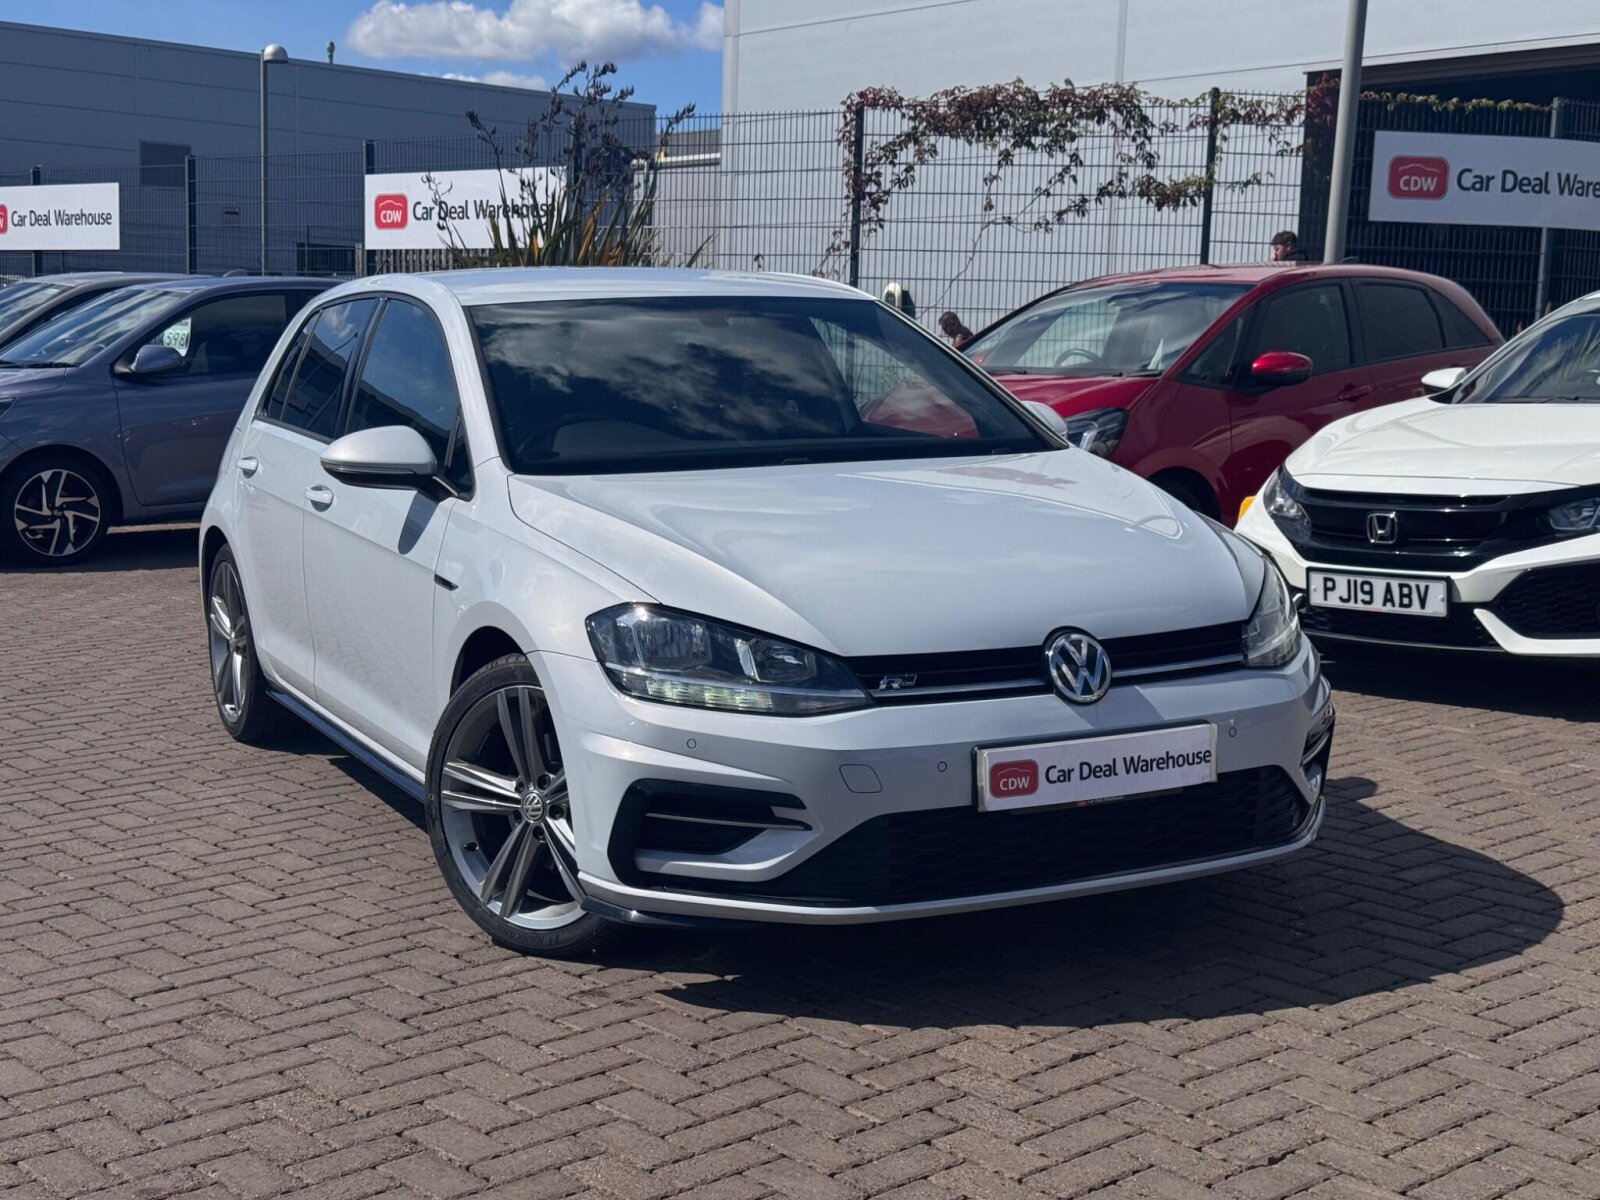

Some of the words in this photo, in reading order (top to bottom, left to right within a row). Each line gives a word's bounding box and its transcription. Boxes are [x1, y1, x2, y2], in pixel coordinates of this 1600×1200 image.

[1399, 174, 1439, 192] CDW
[1456, 168, 1495, 193] Car
[1500, 169, 1550, 195] Deal
[11, 210, 27, 227] Car
[29, 209, 51, 227] Deal
[54, 208, 112, 226] Warehouse
[380, 210, 402, 224] CDW
[412, 201, 434, 221] Car
[438, 200, 470, 221] Deal
[1323, 576, 1374, 606] PJ19
[1382, 582, 1430, 610] ABV
[1045, 765, 1075, 784] Car
[1079, 758, 1118, 781] Deal
[1123, 749, 1213, 775] Warehouse
[999, 776, 1030, 791] CDW
